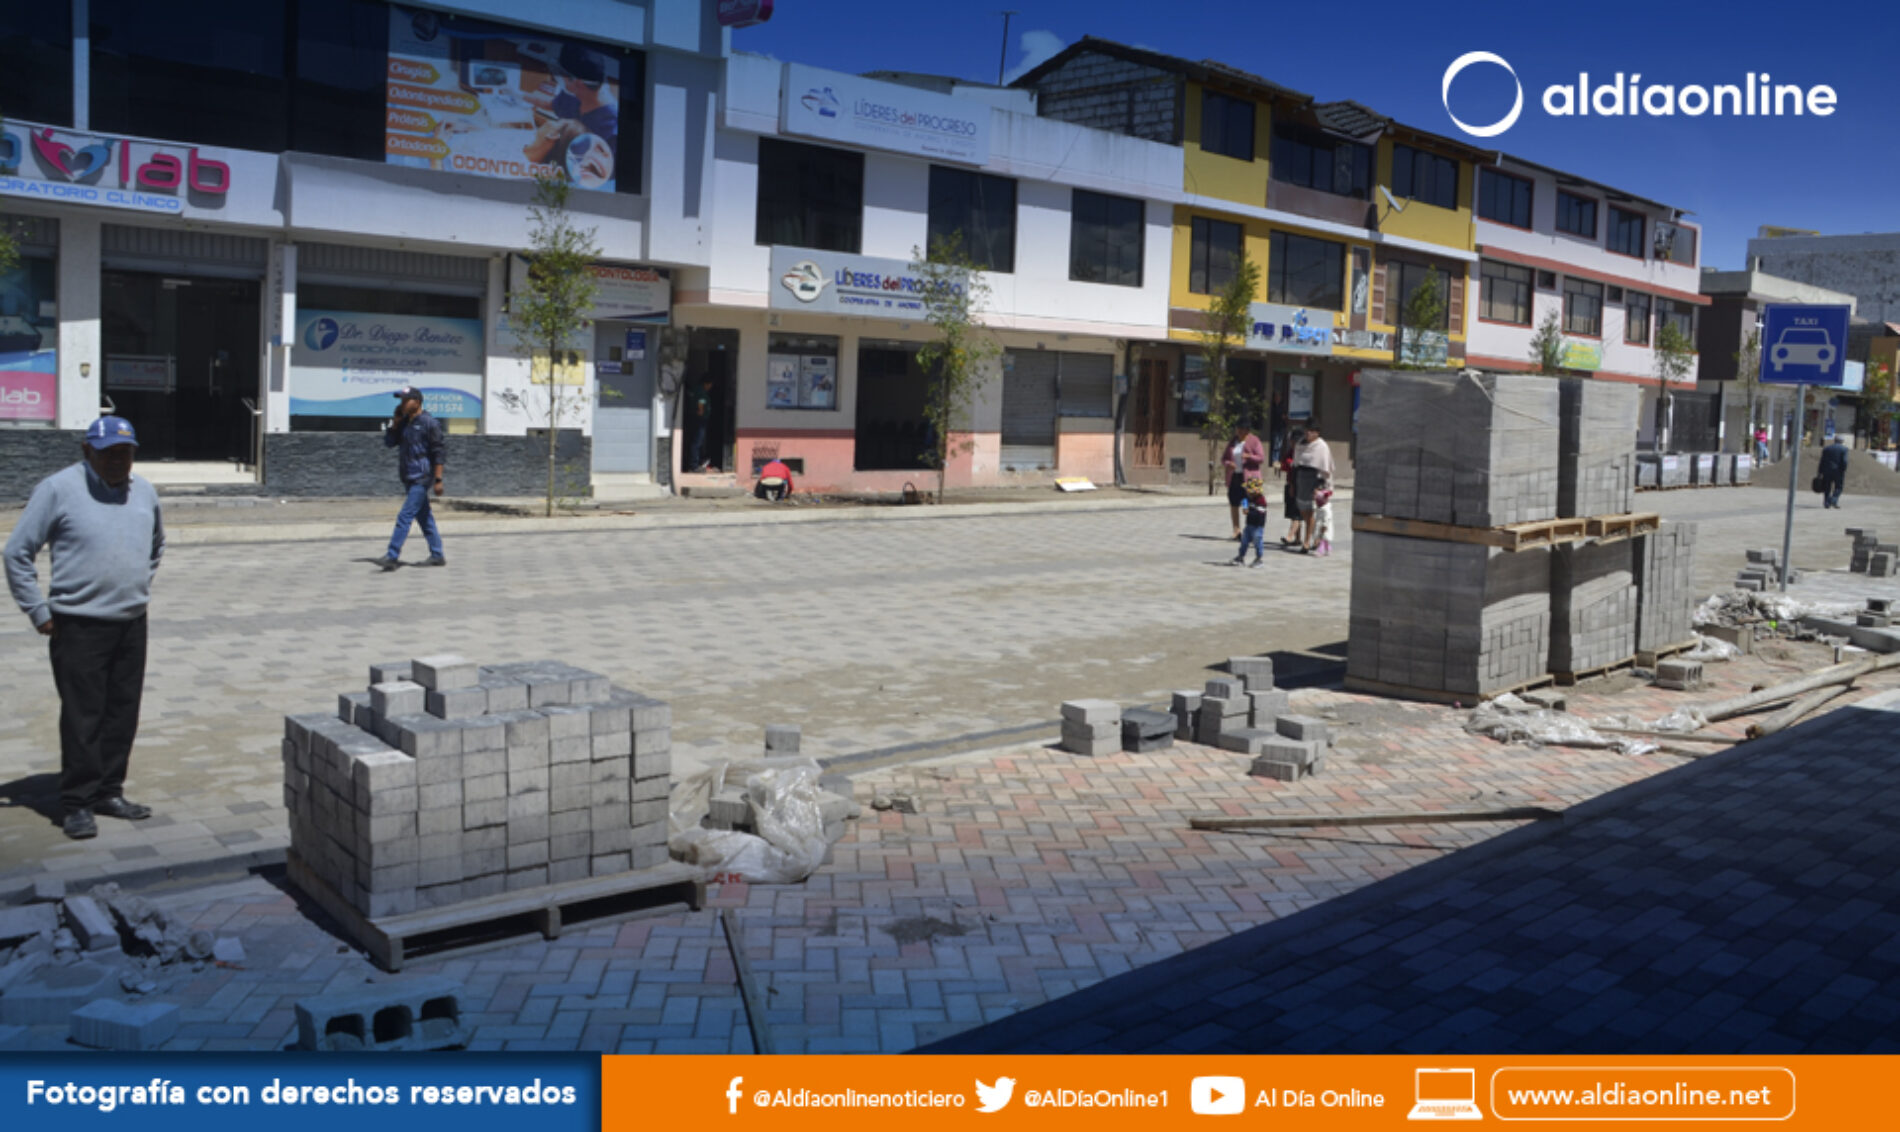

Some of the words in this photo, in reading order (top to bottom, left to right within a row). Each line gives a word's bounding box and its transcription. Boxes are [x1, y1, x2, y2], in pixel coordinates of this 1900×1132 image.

[853, 98, 898, 123] LÍDERES
[899, 110, 917, 126] del
[917, 112, 977, 136] PROGRESO
[120, 138, 230, 193] lab
[106, 190, 180, 210] CLÍNICO
[835, 267, 881, 290] LÍDERES
[882, 275, 900, 291] del
[1794, 317, 1819, 326] TAXI
[340, 323, 363, 340] Dr.
[368, 324, 409, 346] Diego
[1, 386, 41, 405] lab
